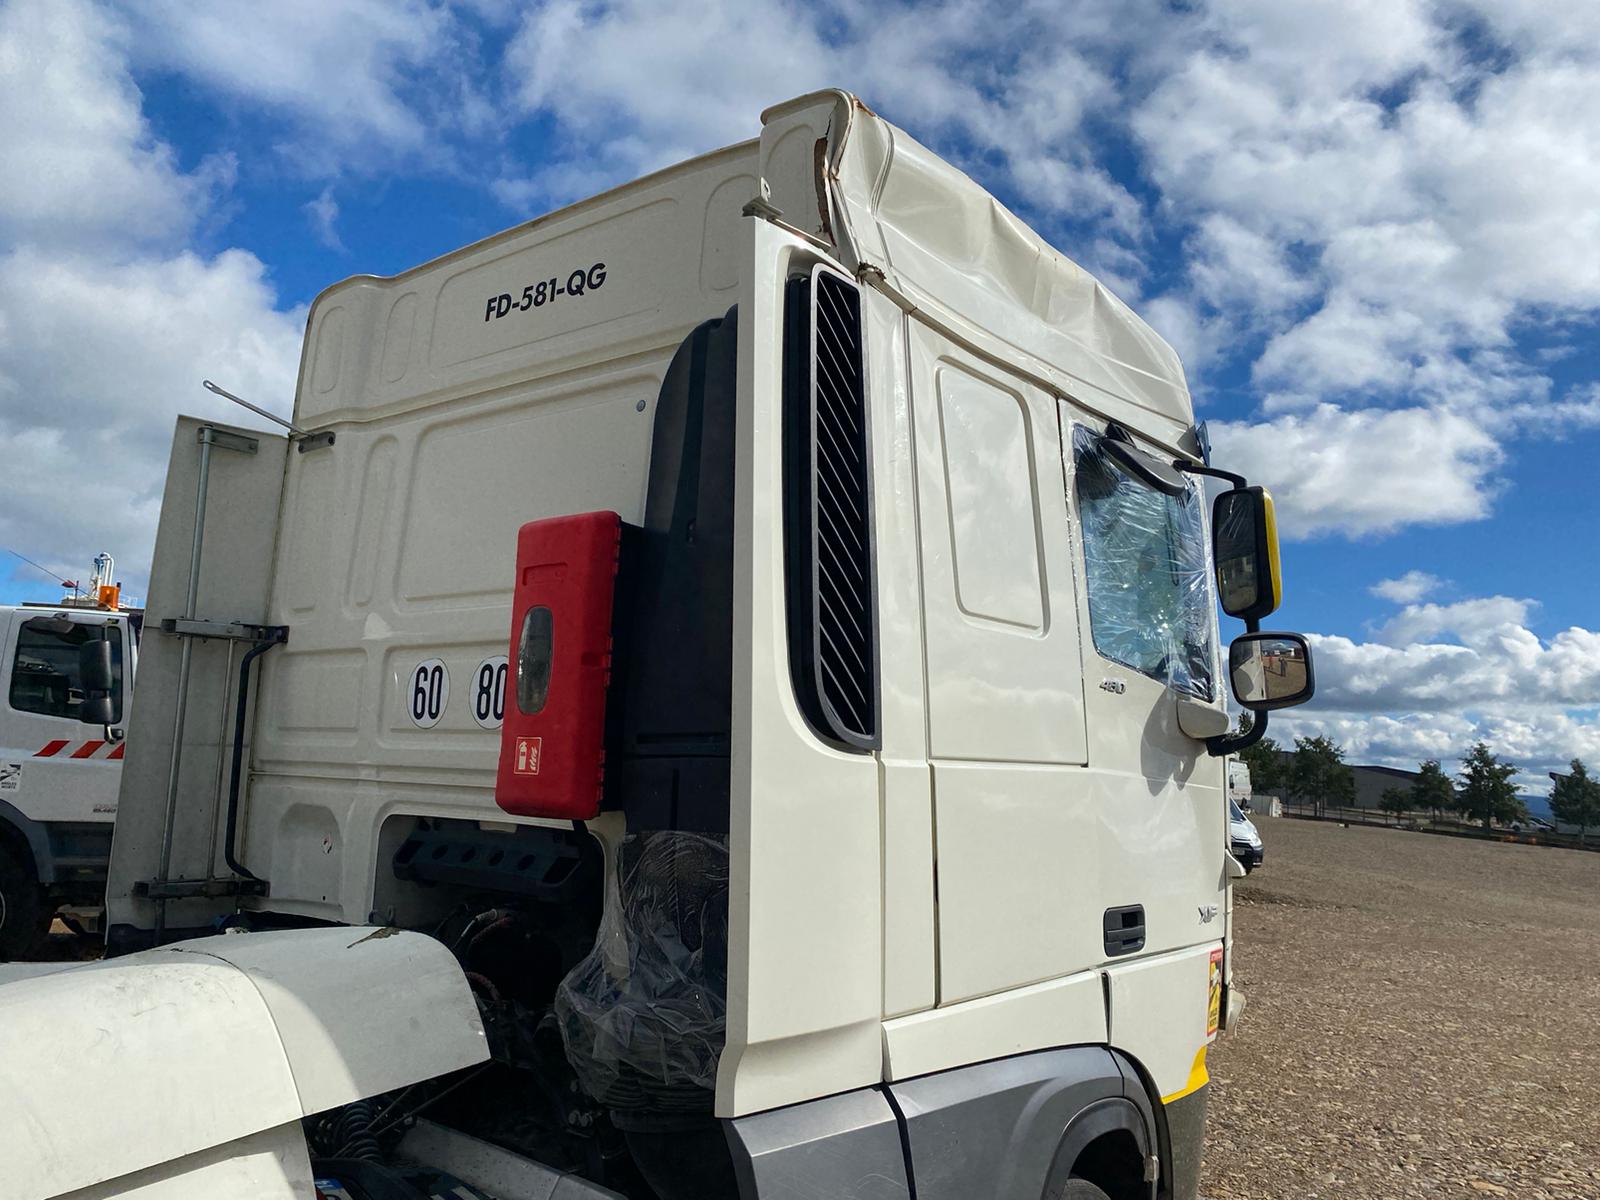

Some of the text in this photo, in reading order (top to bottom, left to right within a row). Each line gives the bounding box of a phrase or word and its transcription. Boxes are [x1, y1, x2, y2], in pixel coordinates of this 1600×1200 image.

[485, 262, 607, 322] FD-581-QG
[413, 665, 443, 720] 60
[476, 663, 508, 720] 80
